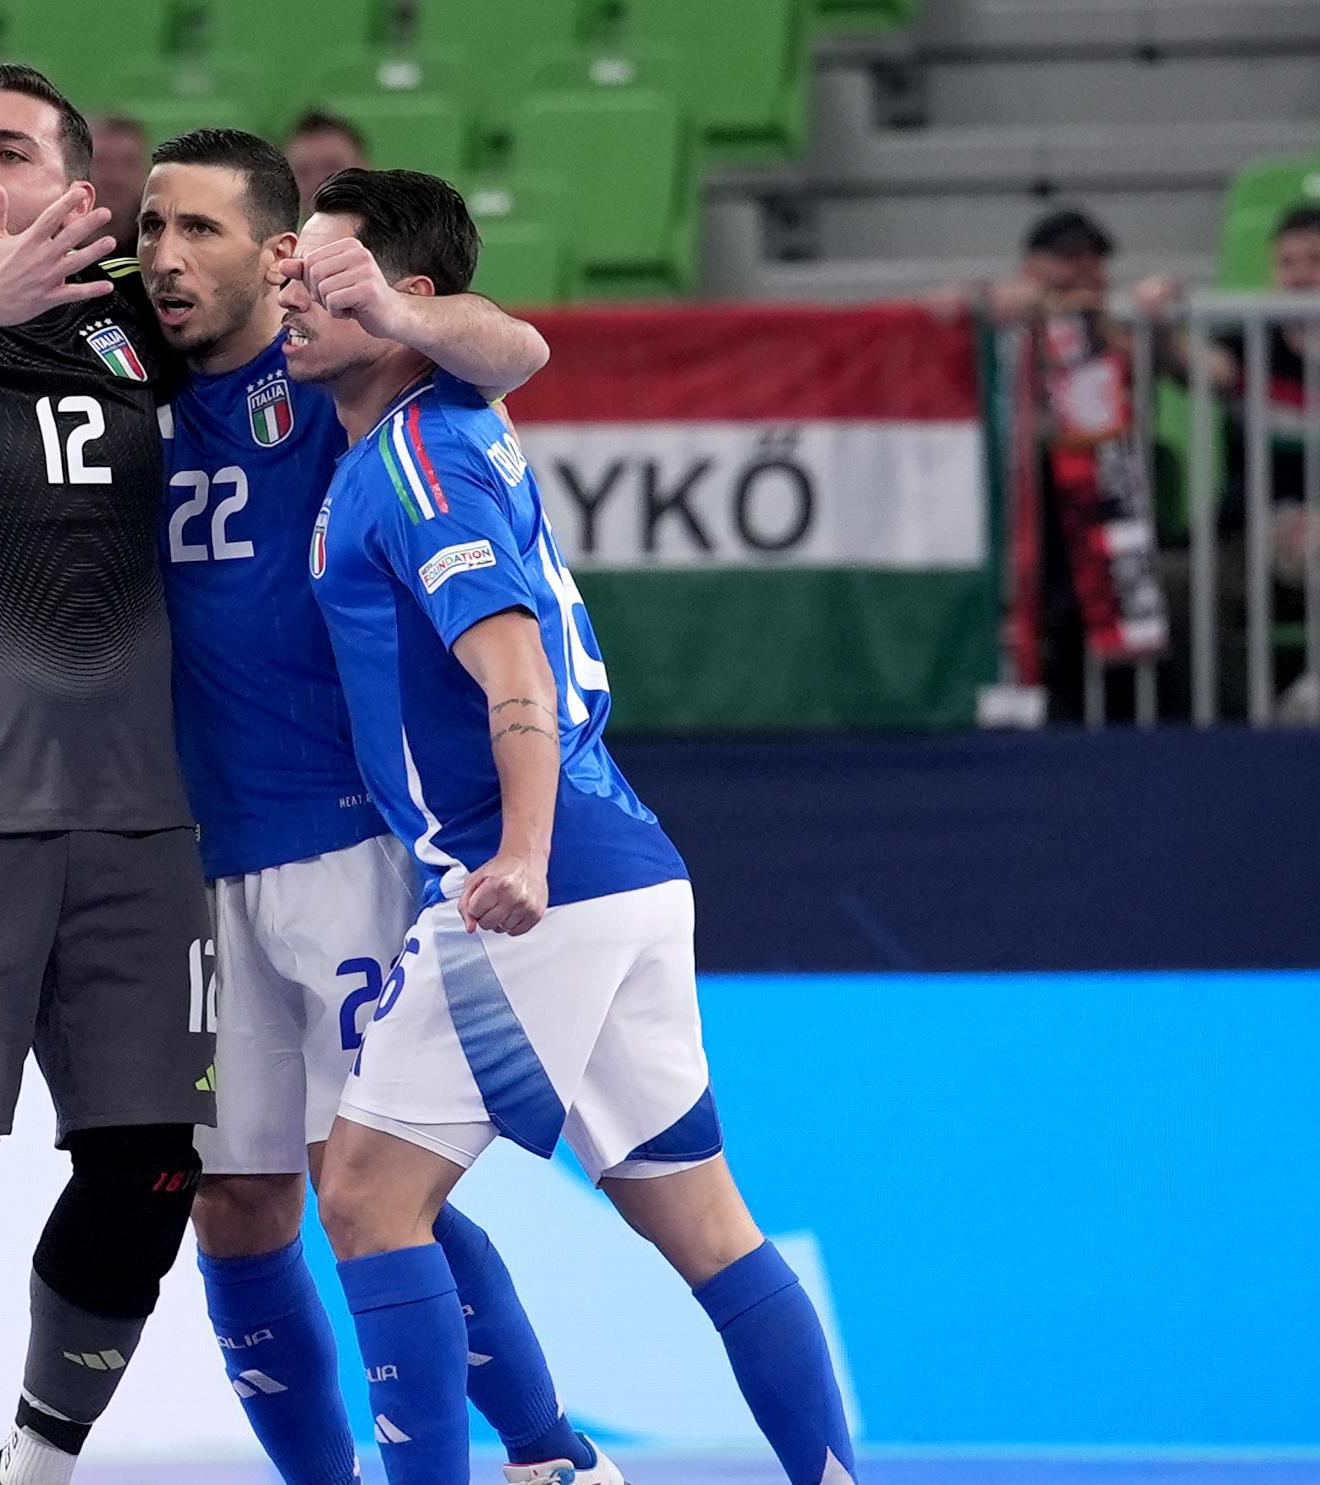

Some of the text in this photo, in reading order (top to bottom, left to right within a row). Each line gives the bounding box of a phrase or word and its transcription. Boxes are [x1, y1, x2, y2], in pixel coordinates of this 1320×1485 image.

[35, 395, 112, 484] 12
[252, 384, 285, 409] ITALIA
[169, 465, 255, 563] 22
[423, 548, 491, 584] FOUNDATION
[336, 956, 400, 1051] 2
